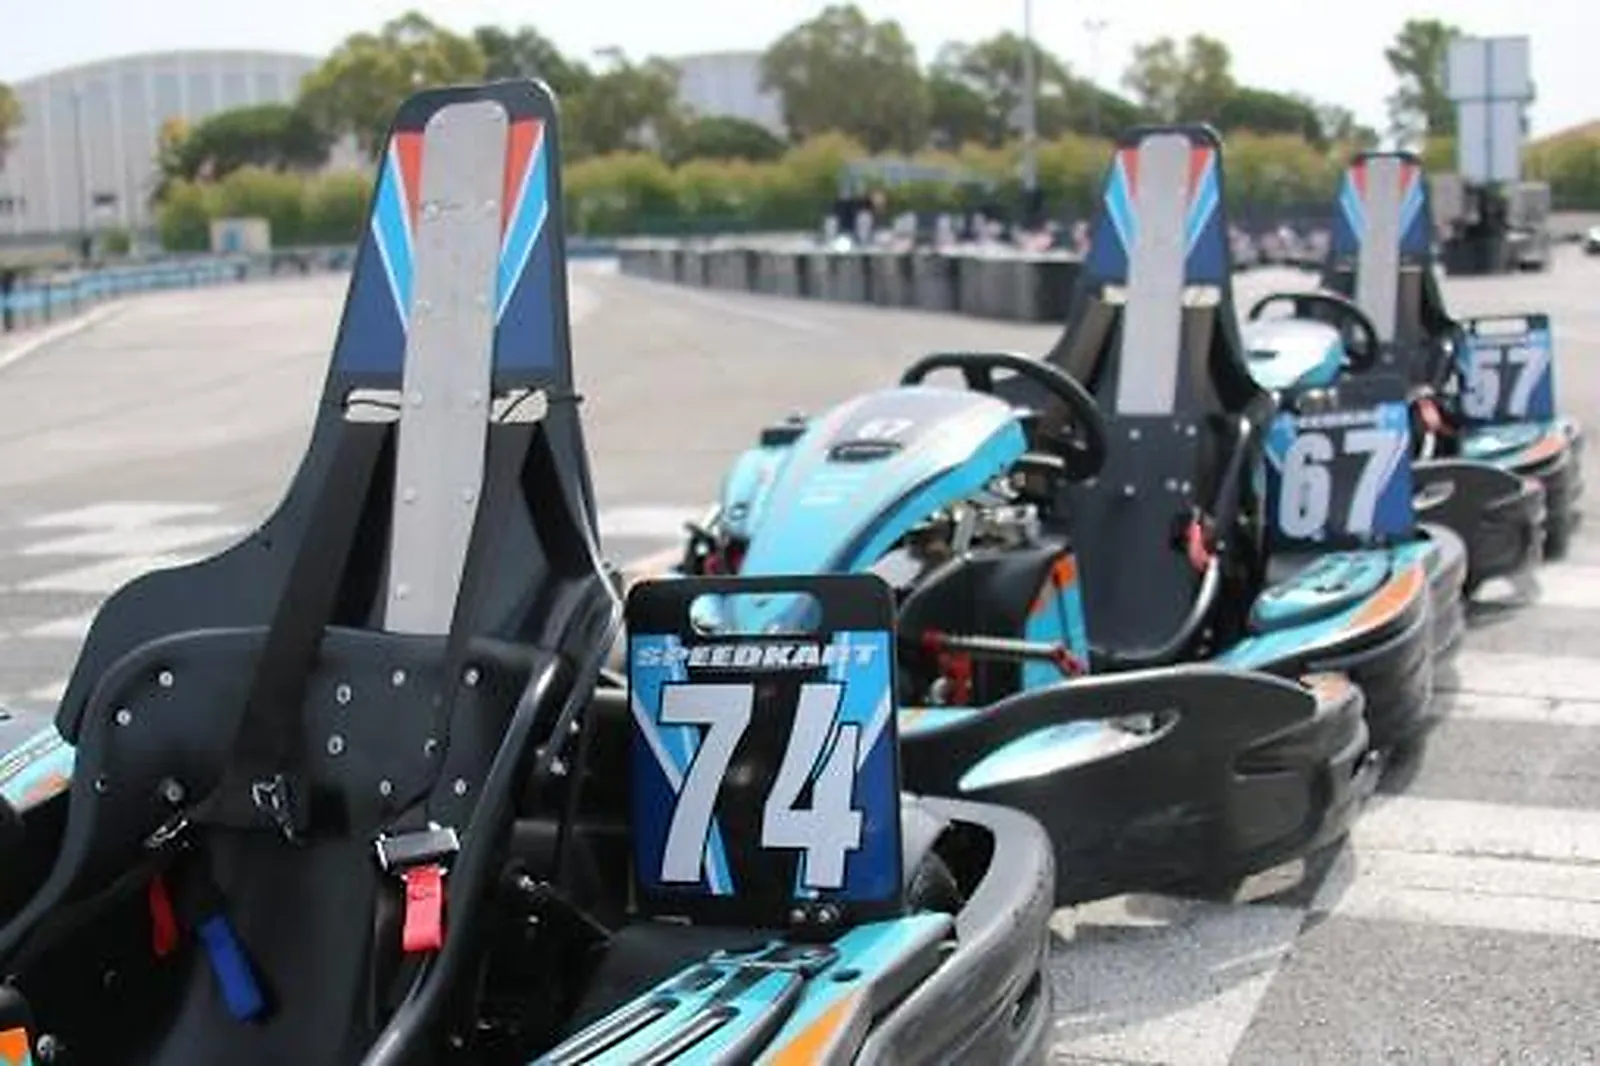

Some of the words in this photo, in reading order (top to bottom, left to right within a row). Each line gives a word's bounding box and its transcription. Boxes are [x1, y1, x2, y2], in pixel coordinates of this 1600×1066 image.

[1465, 347, 1549, 420] 57
[1280, 430, 1402, 539] 67
[635, 644, 878, 667] SPEEDKART
[660, 684, 864, 888] 74
